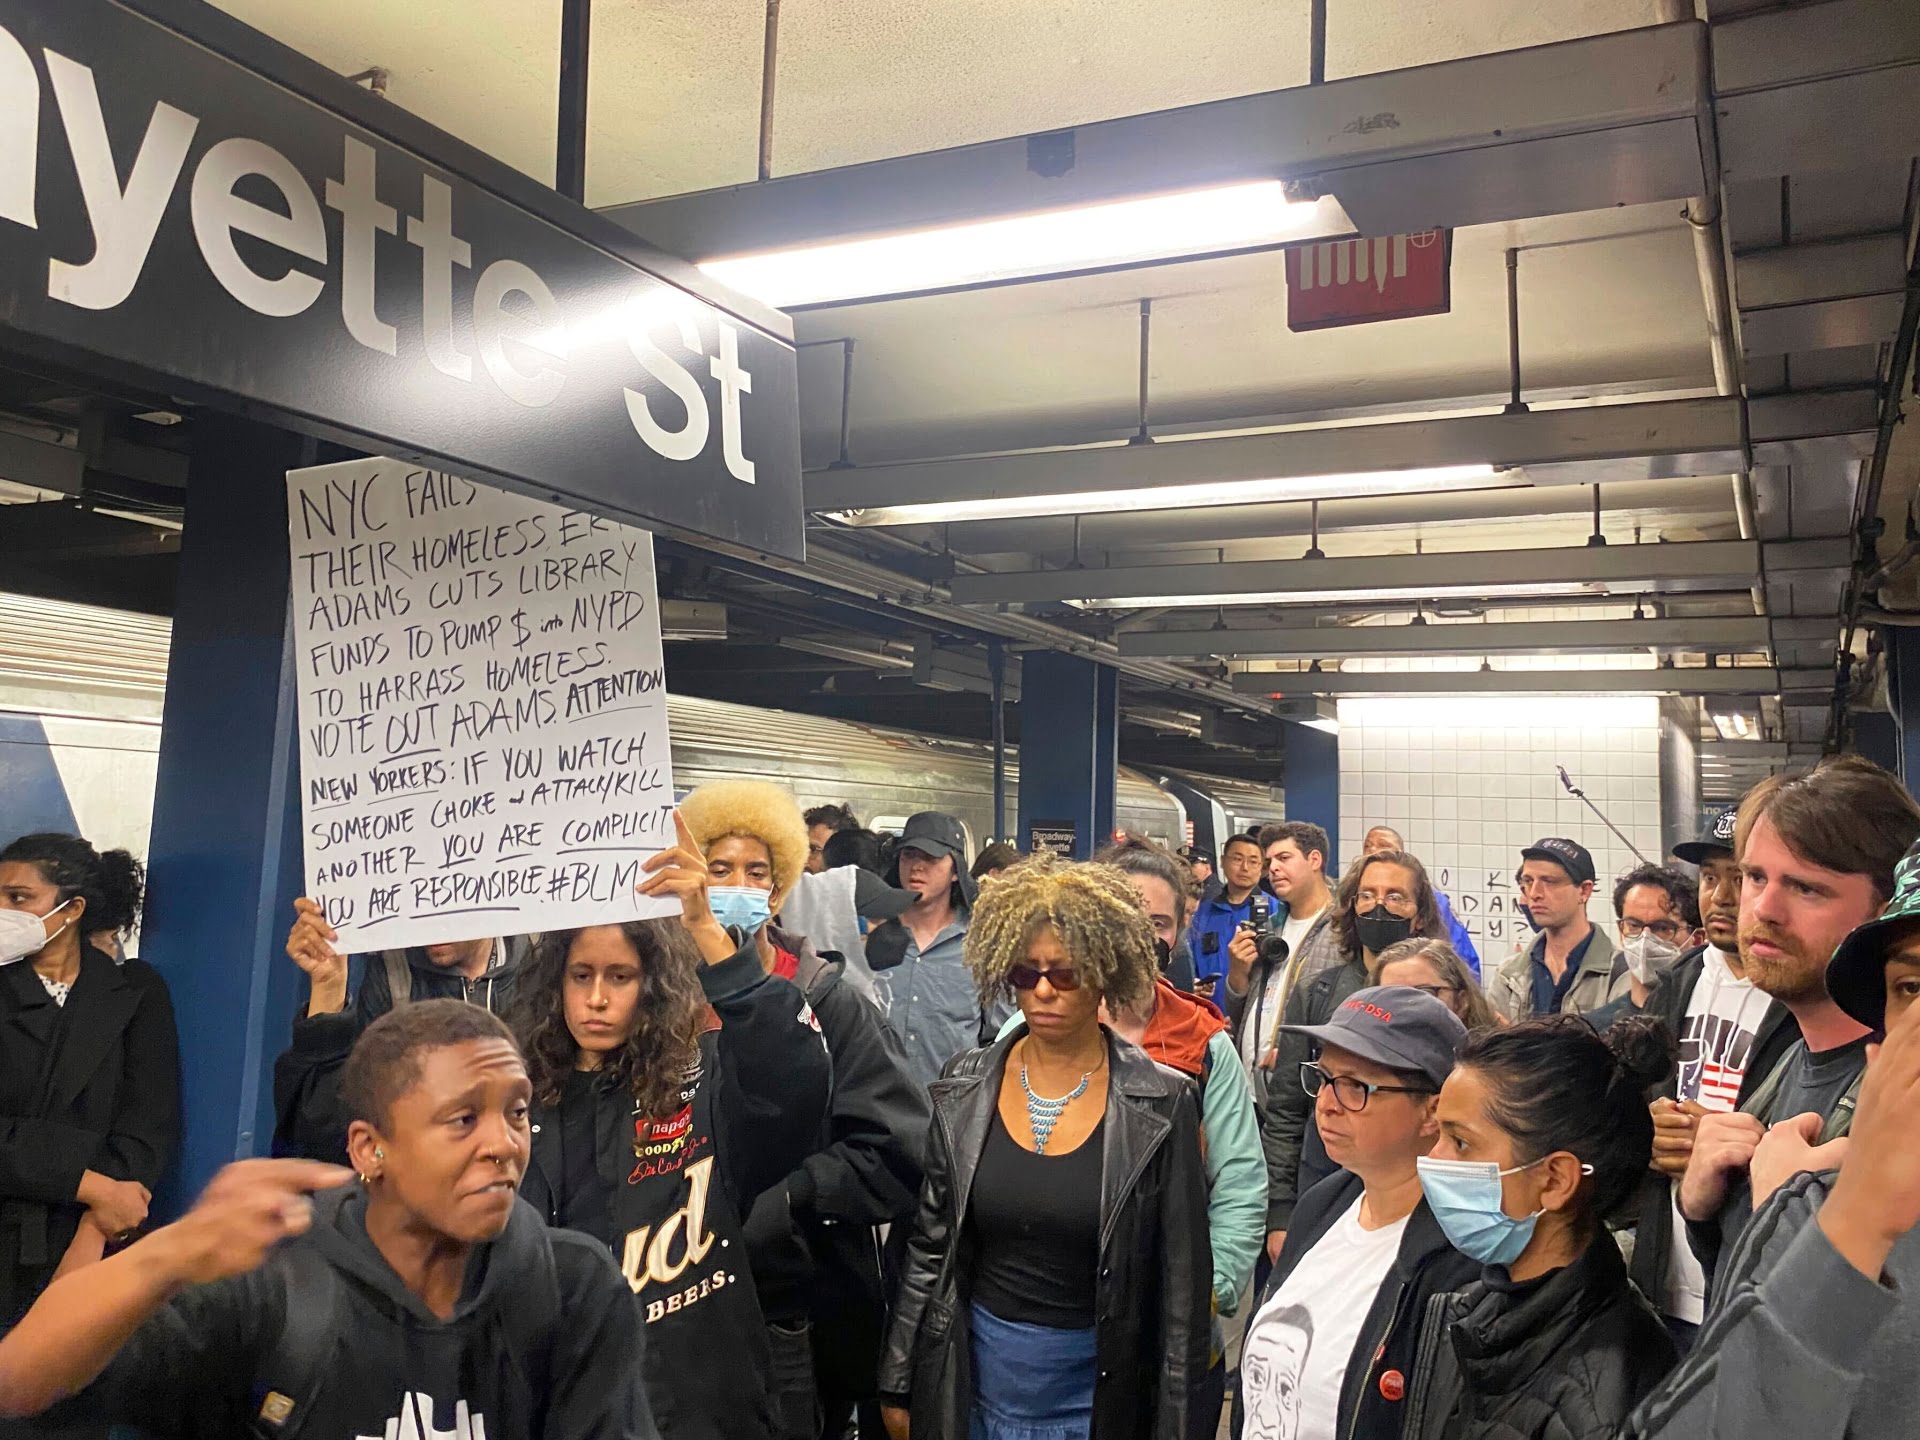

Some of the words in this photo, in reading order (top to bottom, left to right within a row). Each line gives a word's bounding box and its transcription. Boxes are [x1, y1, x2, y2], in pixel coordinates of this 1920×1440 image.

[623, 305, 757, 485] St
[299, 473, 388, 539] NYC
[404, 471, 477, 518] FAILS
[299, 541, 413, 593] THEIR
[309, 585, 411, 631] ADAMS
[429, 570, 503, 609] CUTS
[519, 540, 637, 595] LIBRARY
[310, 633, 390, 676] FUNDS
[403, 625, 434, 660] TO
[440, 615, 501, 656] PUMP
[511, 608, 531, 652] $
[540, 614, 563, 632] into
[571, 590, 644, 633] NYPD
[310, 688, 343, 717] TO
[360, 664, 465, 713] HARRASS
[486, 641, 612, 692] HOMELESS.
[310, 713, 374, 758] VOTE
[386, 703, 440, 754] OUT
[450, 689, 557, 747] ADAMS.
[566, 666, 663, 718] ATTENTION
[311, 773, 358, 805] NEW
[369, 760, 455, 795] YORKERS:
[464, 751, 488, 785] IF
[502, 747, 543, 782] YOU
[559, 731, 646, 772] WATCH
[311, 808, 414, 850] SOMEONE
[431, 791, 496, 828] CHOKE
[316, 846, 425, 886] ANOTHER
[443, 832, 484, 869] YOU
[498, 822, 544, 852] ARE
[561, 805, 673, 846] COMPLICIT
[316, 894, 355, 925] YOU
[369, 883, 402, 918] ARE
[546, 860, 639, 912] #BLM
[621, 1155, 715, 1294] ud
